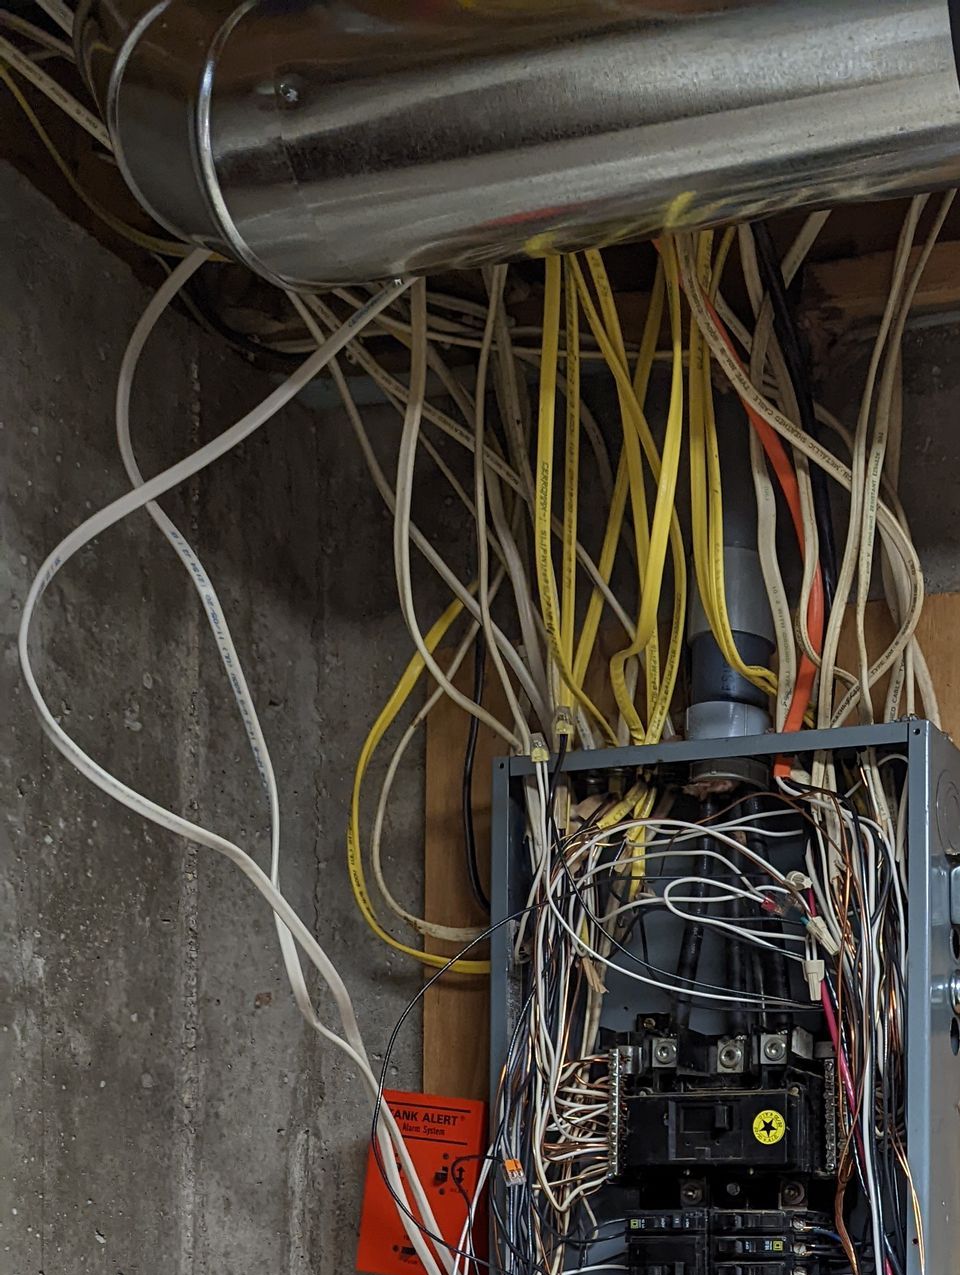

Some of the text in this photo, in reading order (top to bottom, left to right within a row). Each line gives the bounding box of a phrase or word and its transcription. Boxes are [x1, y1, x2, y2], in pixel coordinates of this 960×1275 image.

[869, 659, 886, 676] TYPE
[890, 678, 901, 703] CABLE
[422, 1112, 458, 1126] ALERT
[403, 1122, 446, 1137] Alarm System
